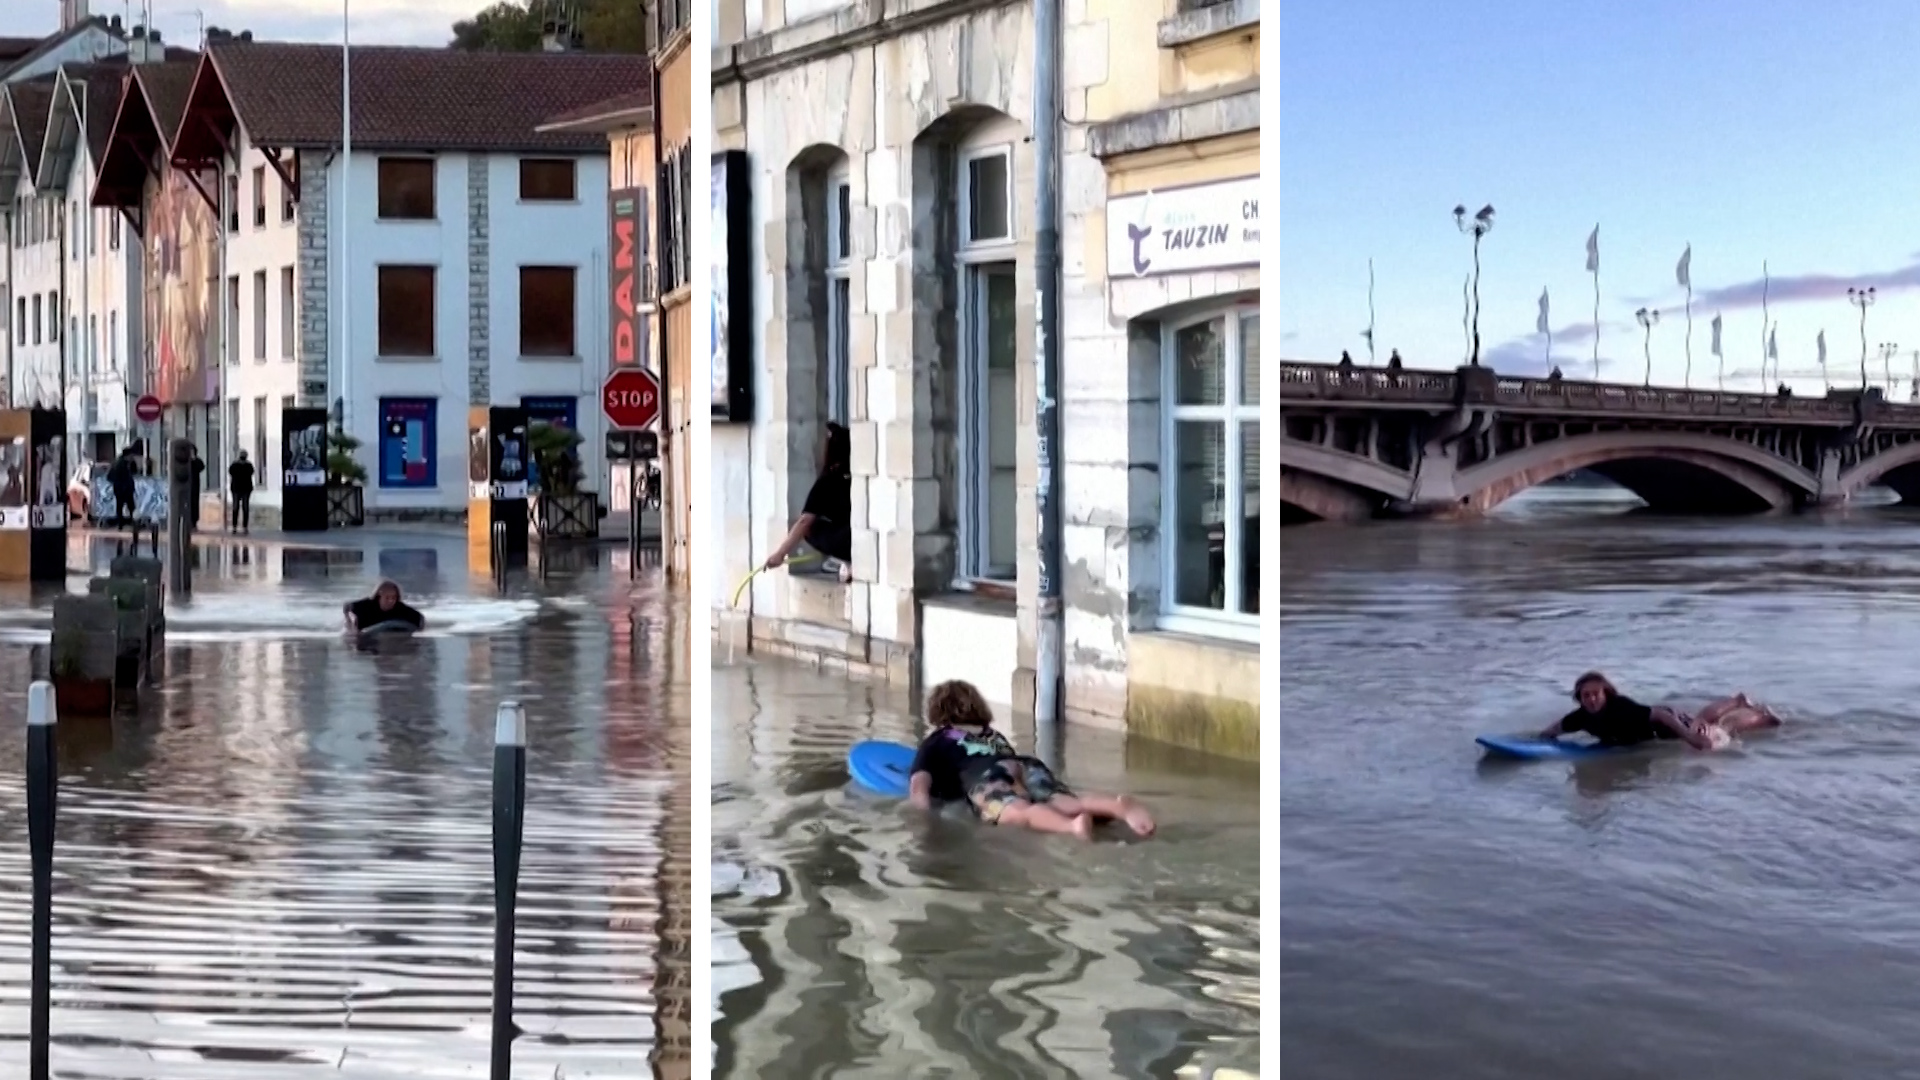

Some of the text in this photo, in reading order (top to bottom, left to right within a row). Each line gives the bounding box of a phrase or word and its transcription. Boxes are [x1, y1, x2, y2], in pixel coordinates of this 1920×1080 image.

[1242, 199, 1260, 219] CH
[1162, 223, 1229, 250] TAUZIN
[608, 390, 654, 408] STOP
[34, 511, 45, 526] 10
